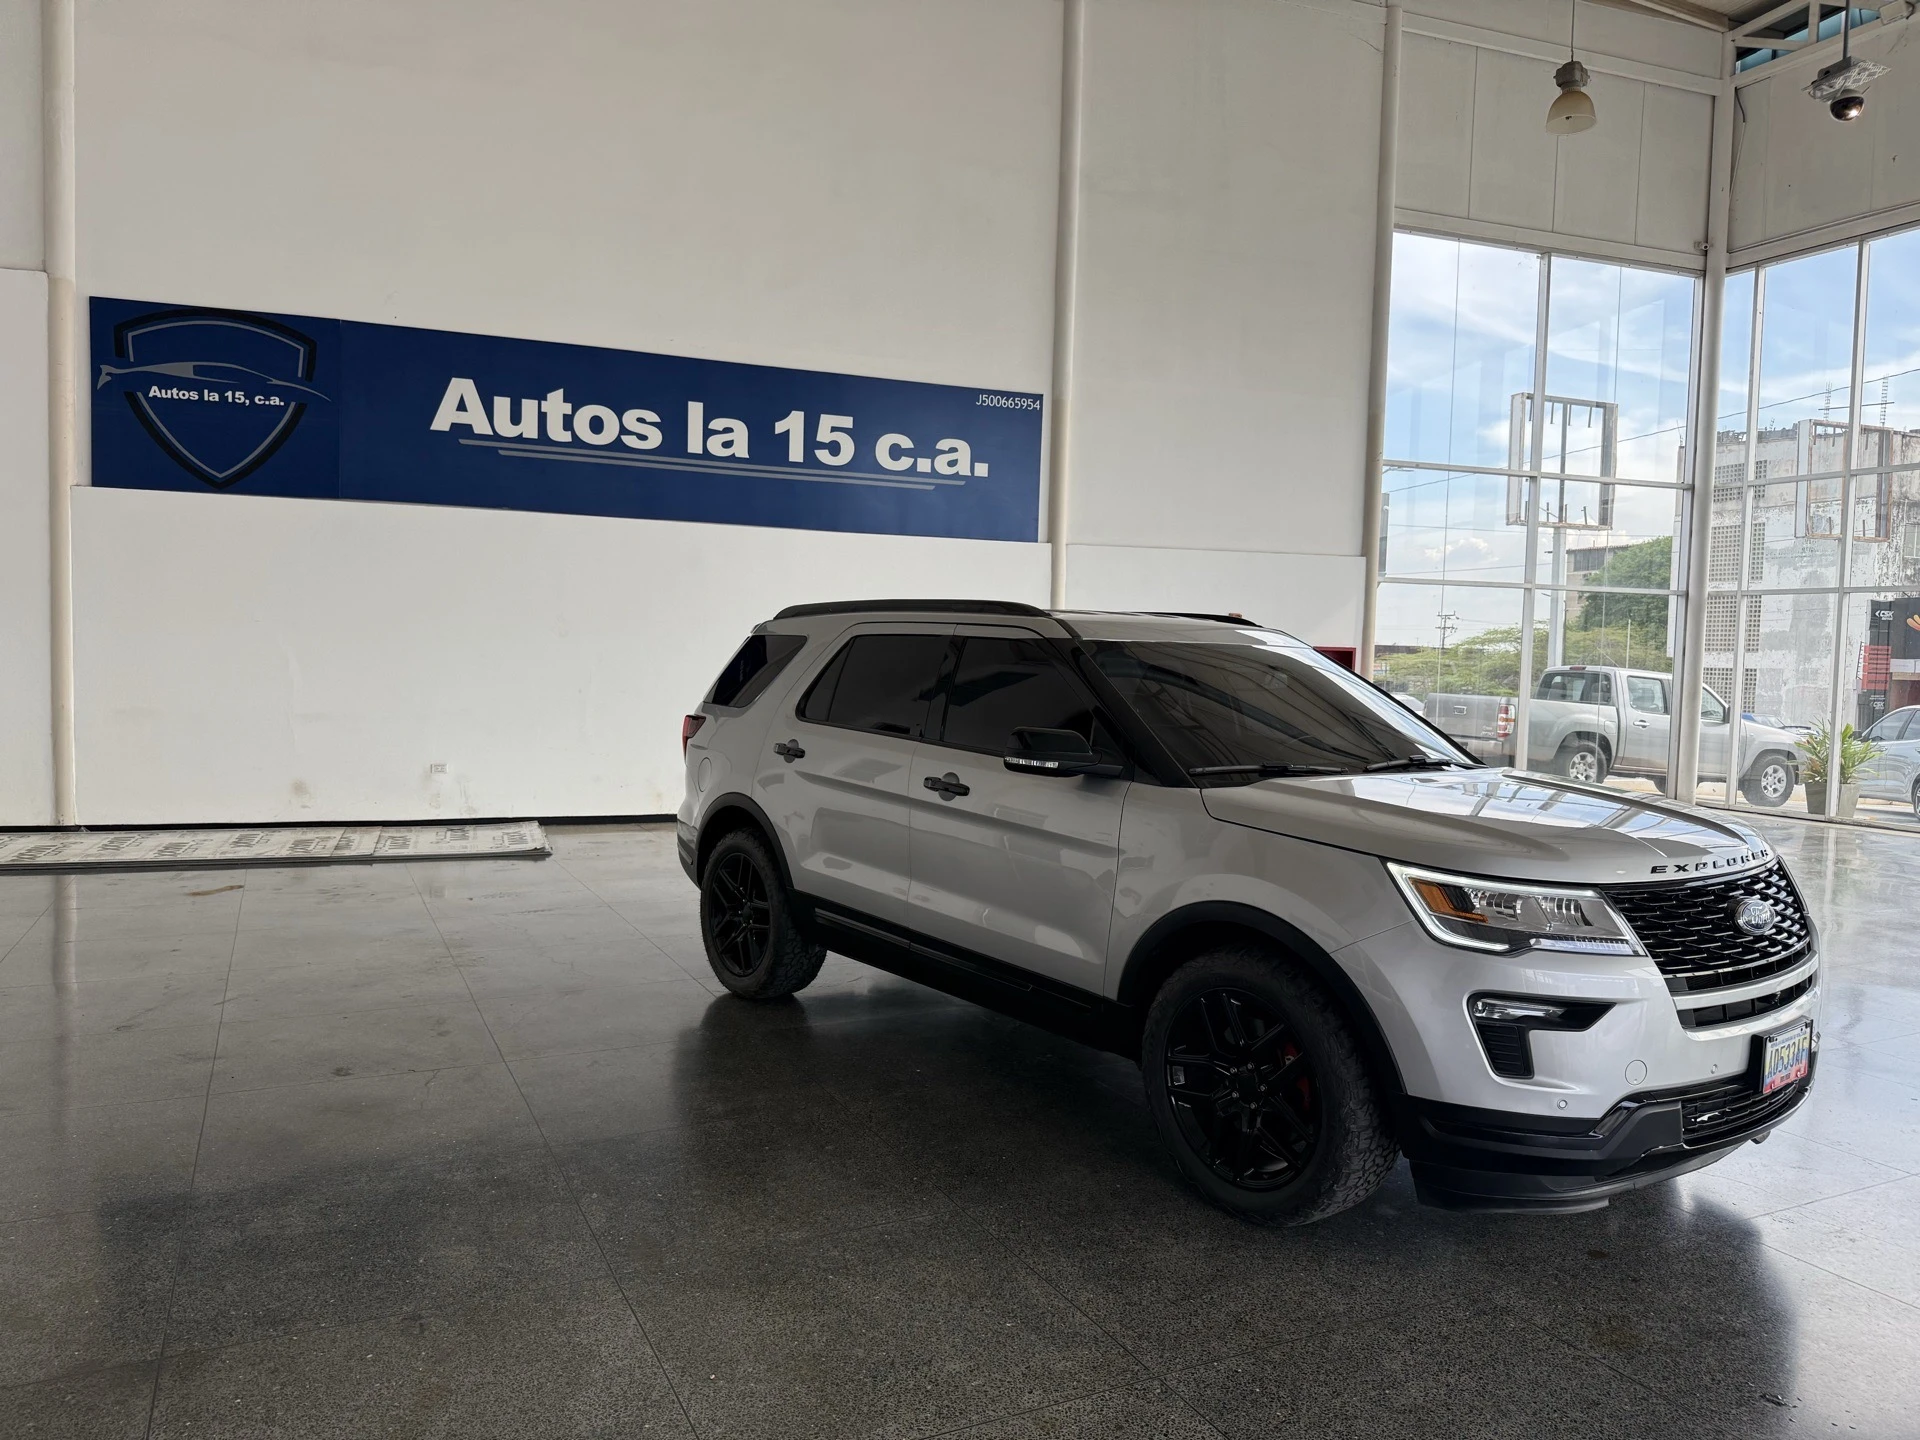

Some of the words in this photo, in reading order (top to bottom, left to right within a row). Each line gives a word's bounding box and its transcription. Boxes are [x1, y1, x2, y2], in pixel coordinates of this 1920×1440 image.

[148, 385, 200, 401] Autos
[203, 389, 219, 402] la
[224, 390, 250, 406] 15,
[254, 395, 286, 407] c.a.
[976, 393, 1042, 411] J500665954
[430, 377, 663, 450] Autos
[687, 401, 750, 459] la
[774, 410, 855, 466] 15
[875, 433, 989, 478] c.a.
[1650, 849, 1769, 875] EXPLORER
